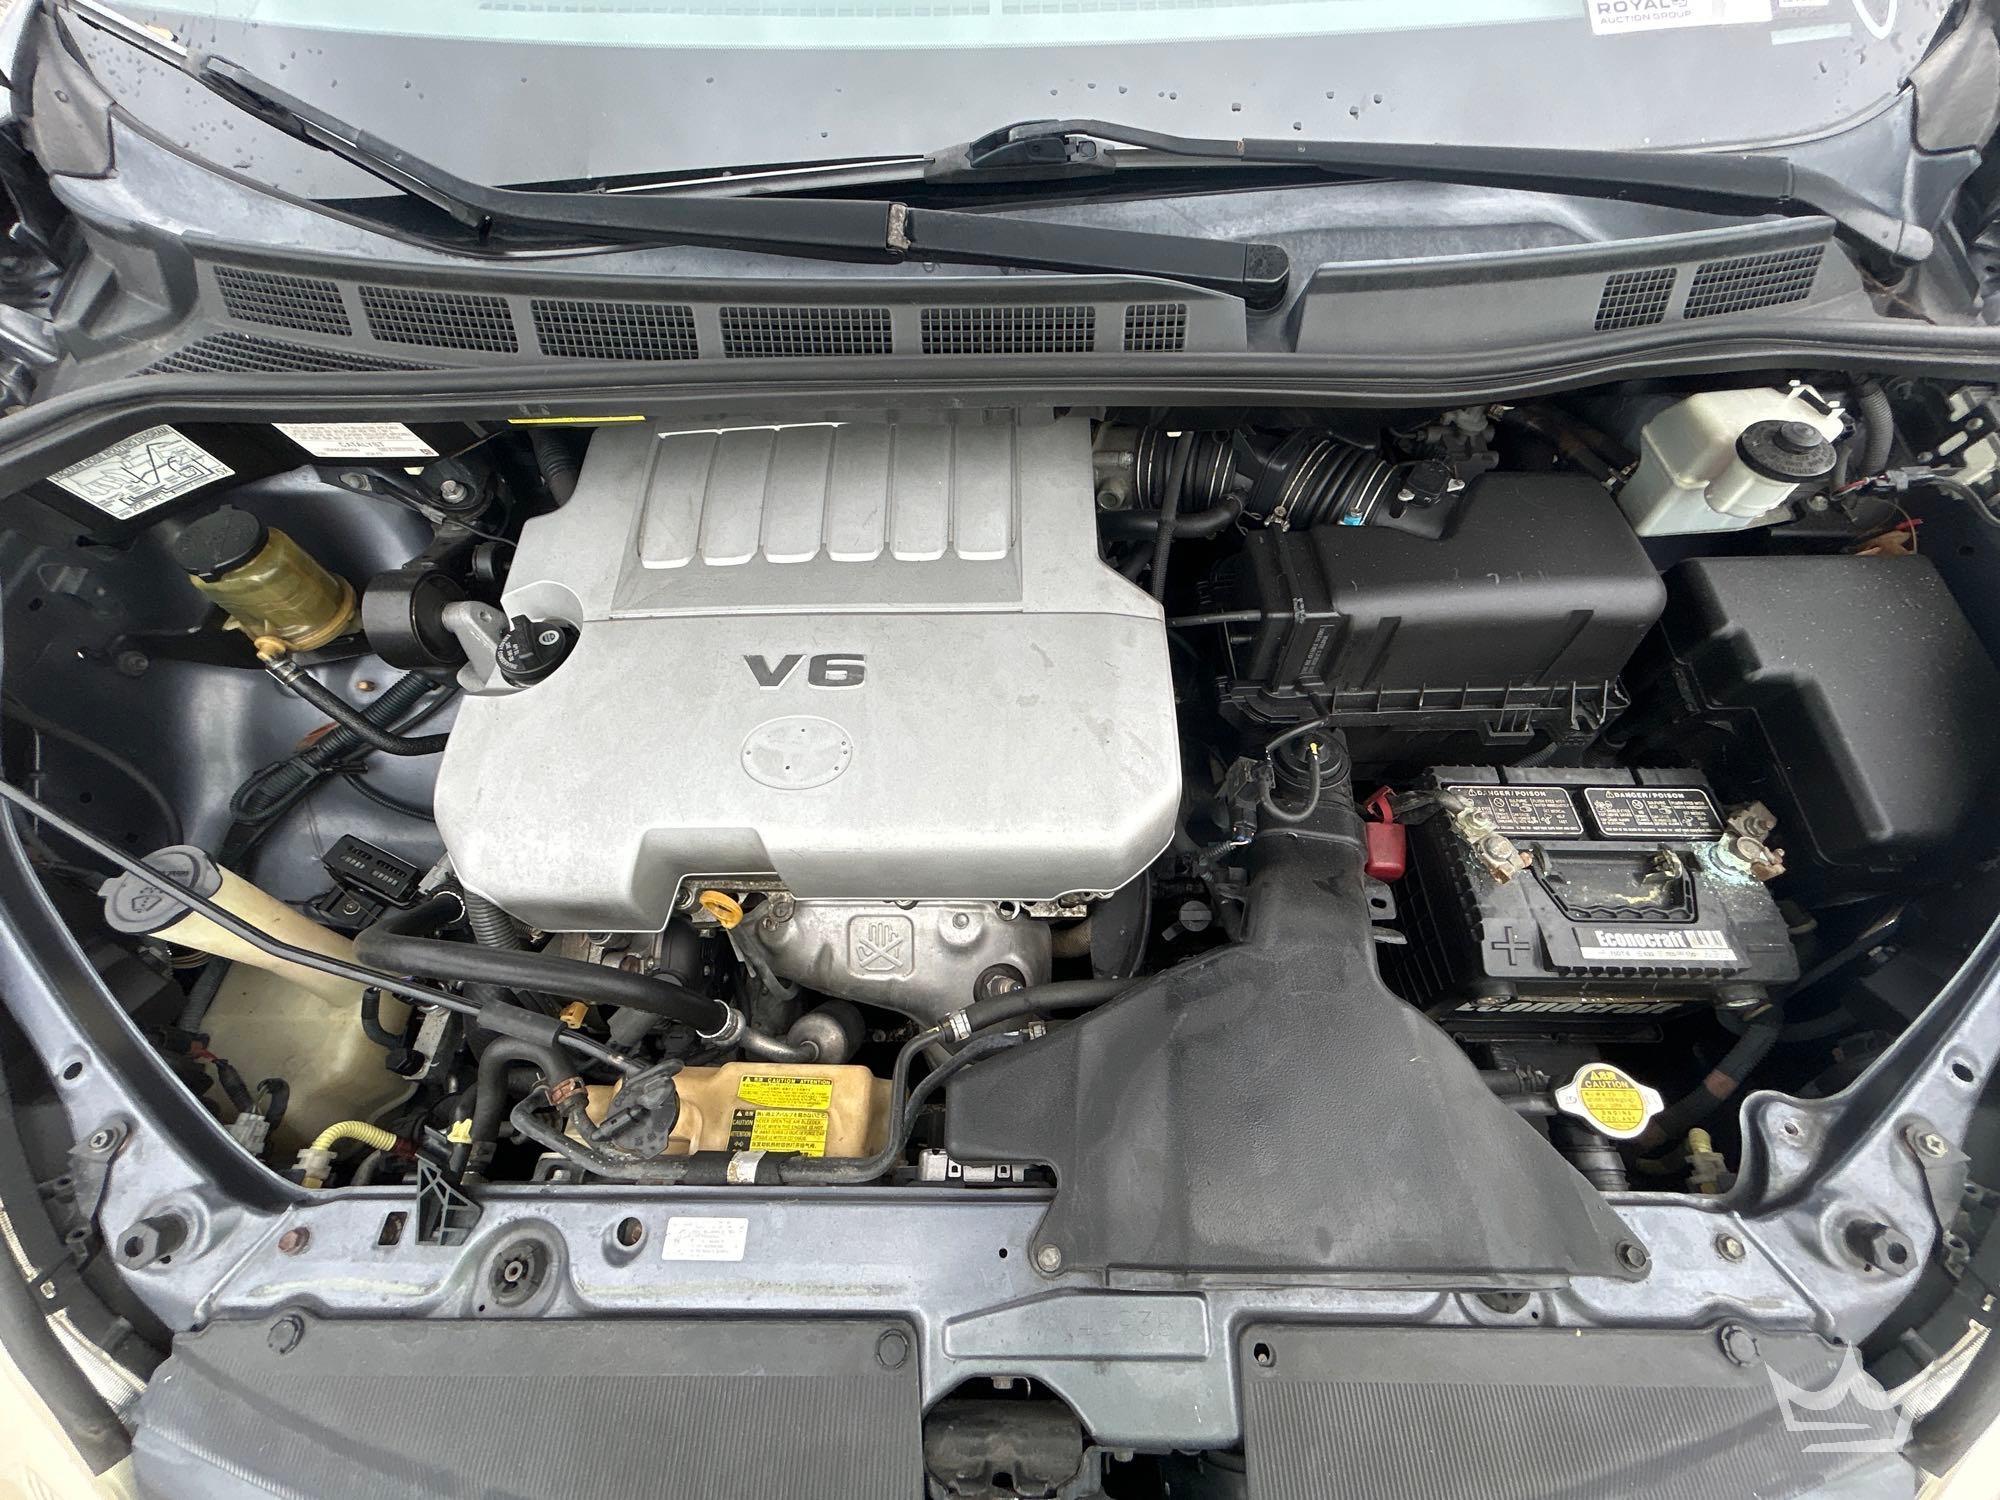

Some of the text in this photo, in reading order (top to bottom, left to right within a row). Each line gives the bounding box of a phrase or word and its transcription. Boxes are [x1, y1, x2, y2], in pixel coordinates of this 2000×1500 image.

[1600, 10, 1692, 25] AUCTION GROUP
[743, 653, 866, 690] V6
[1594, 930, 1687, 948] Econocraft
[1585, 1080, 1628, 1088] CAUTION
